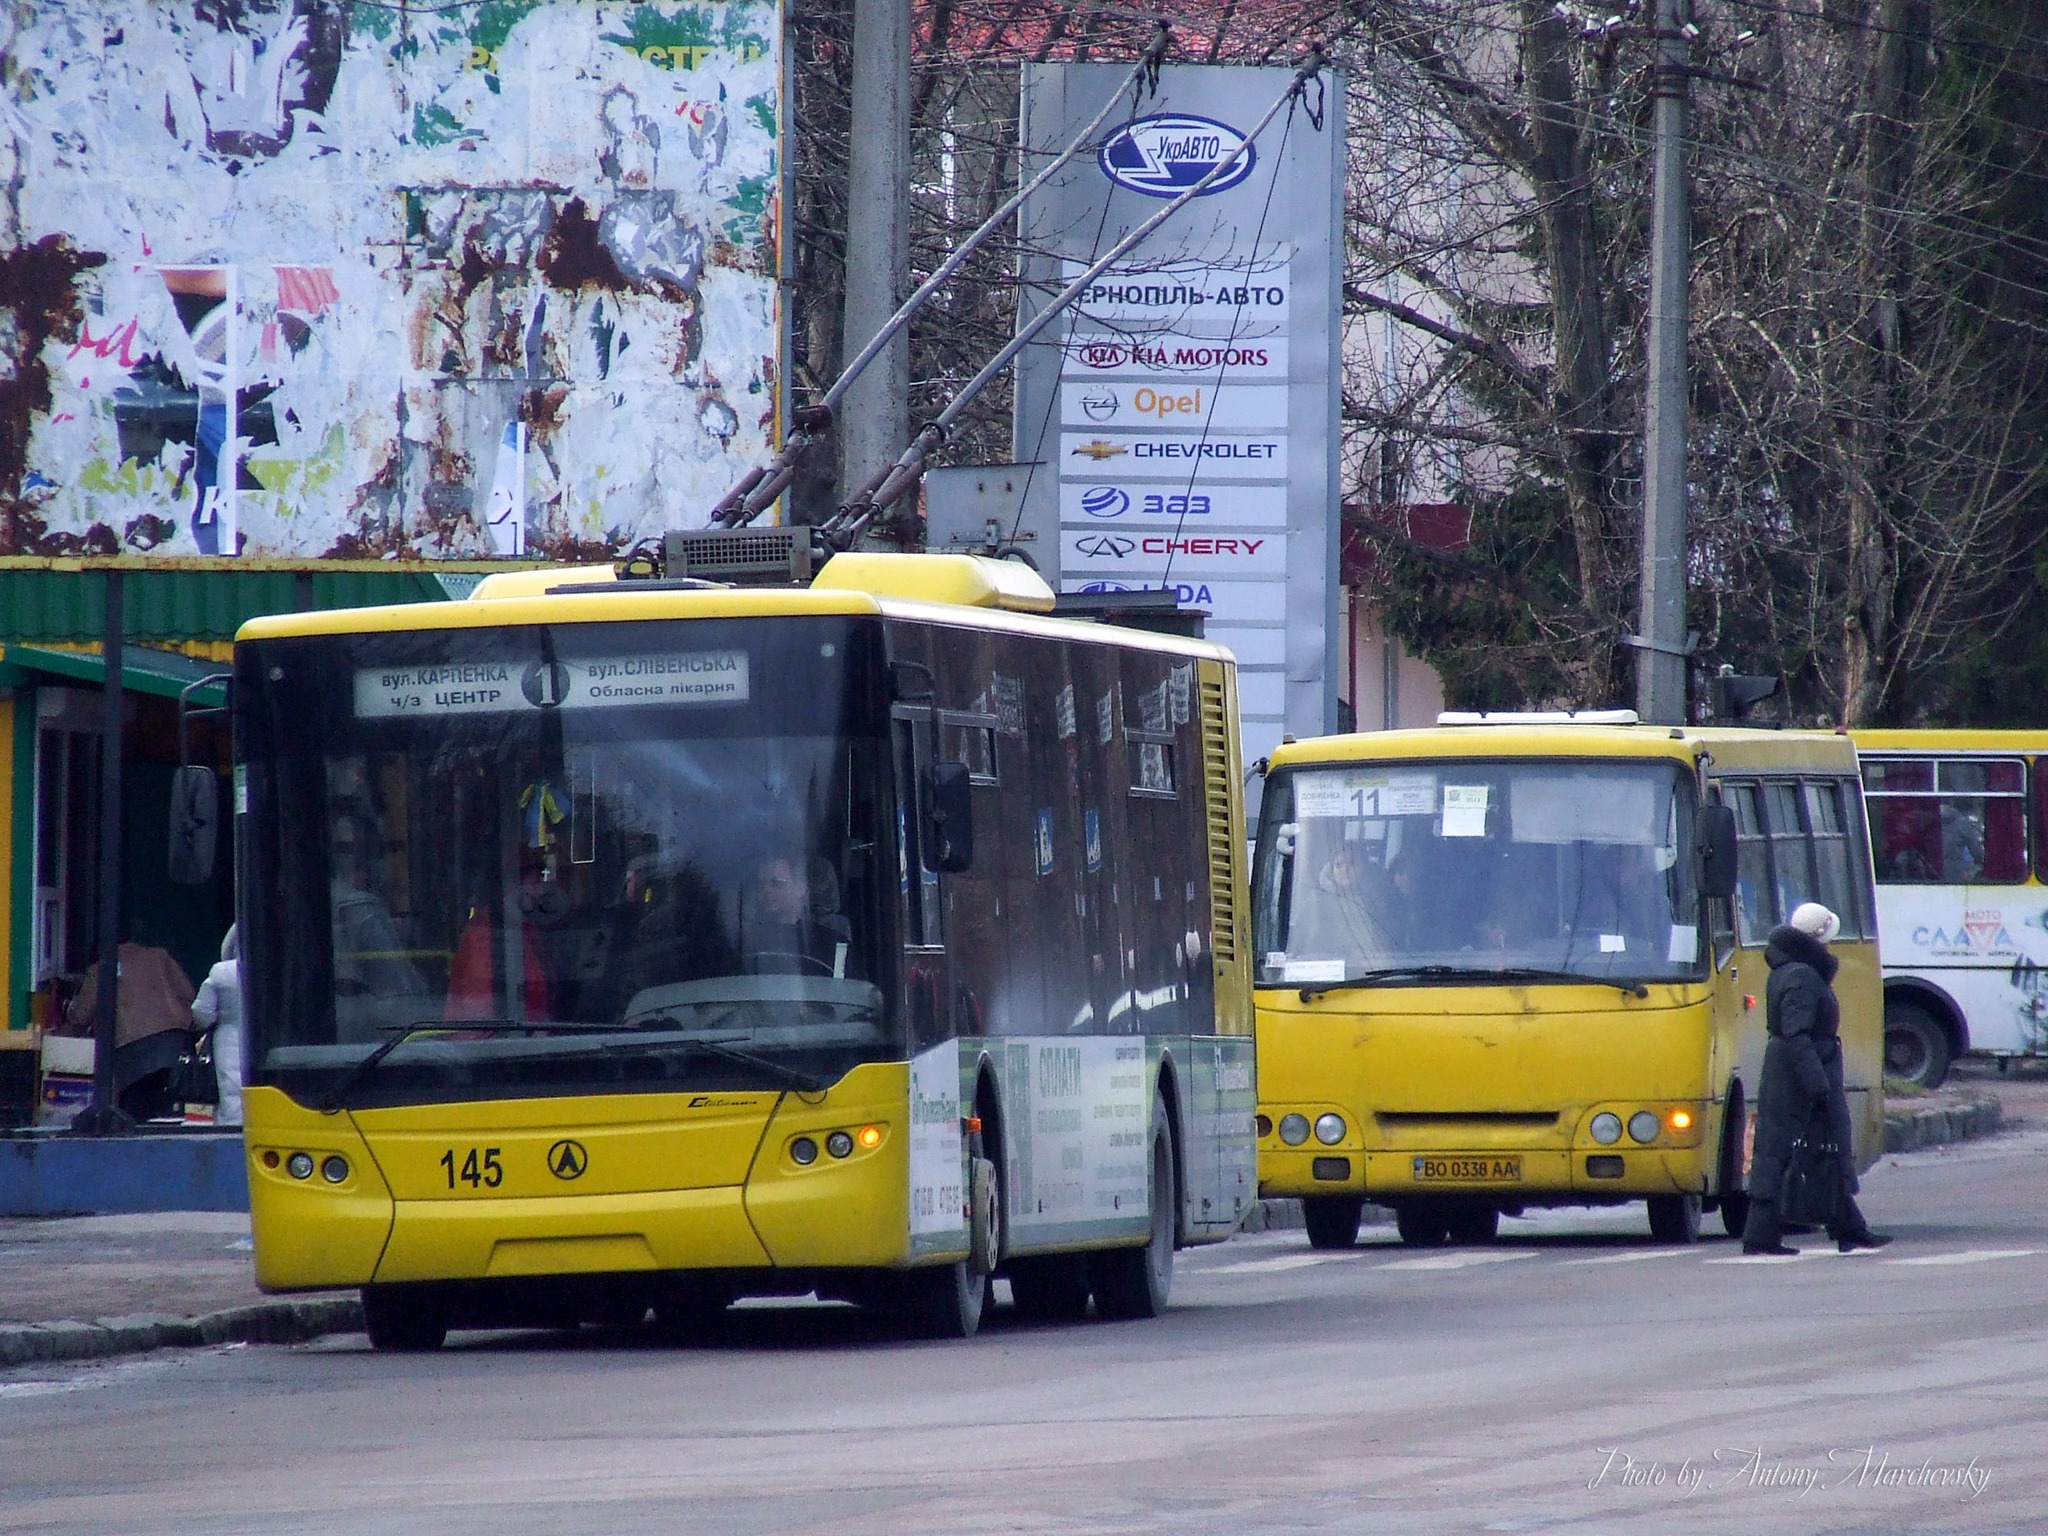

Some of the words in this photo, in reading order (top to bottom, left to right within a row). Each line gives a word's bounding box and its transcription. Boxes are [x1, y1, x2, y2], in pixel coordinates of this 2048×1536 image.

[1156, 136, 1220, 165] УкрАВТО
[1070, 285, 1285, 306] ЕРНОПІЛЬ-АВТО
[1132, 348, 1168, 364] KIA
[1175, 348, 1269, 366] MOTORS
[1134, 387, 1201, 418] Opel
[1134, 443, 1278, 458] CHEVROLET
[1142, 538, 1264, 555] CHERY
[1143, 584, 1213, 604] DA
[534, 663, 556, 704] 1
[589, 685, 664, 698] Обласна
[670, 682, 736, 695] лікарня
[391, 695, 422, 709] ч/з
[435, 690, 502, 707] ЦЕНТР
[1350, 788, 1380, 816] 11
[440, 1148, 503, 1189] 145
[1424, 1161, 1447, 1177] BO
[1492, 1161, 1514, 1177] AA
